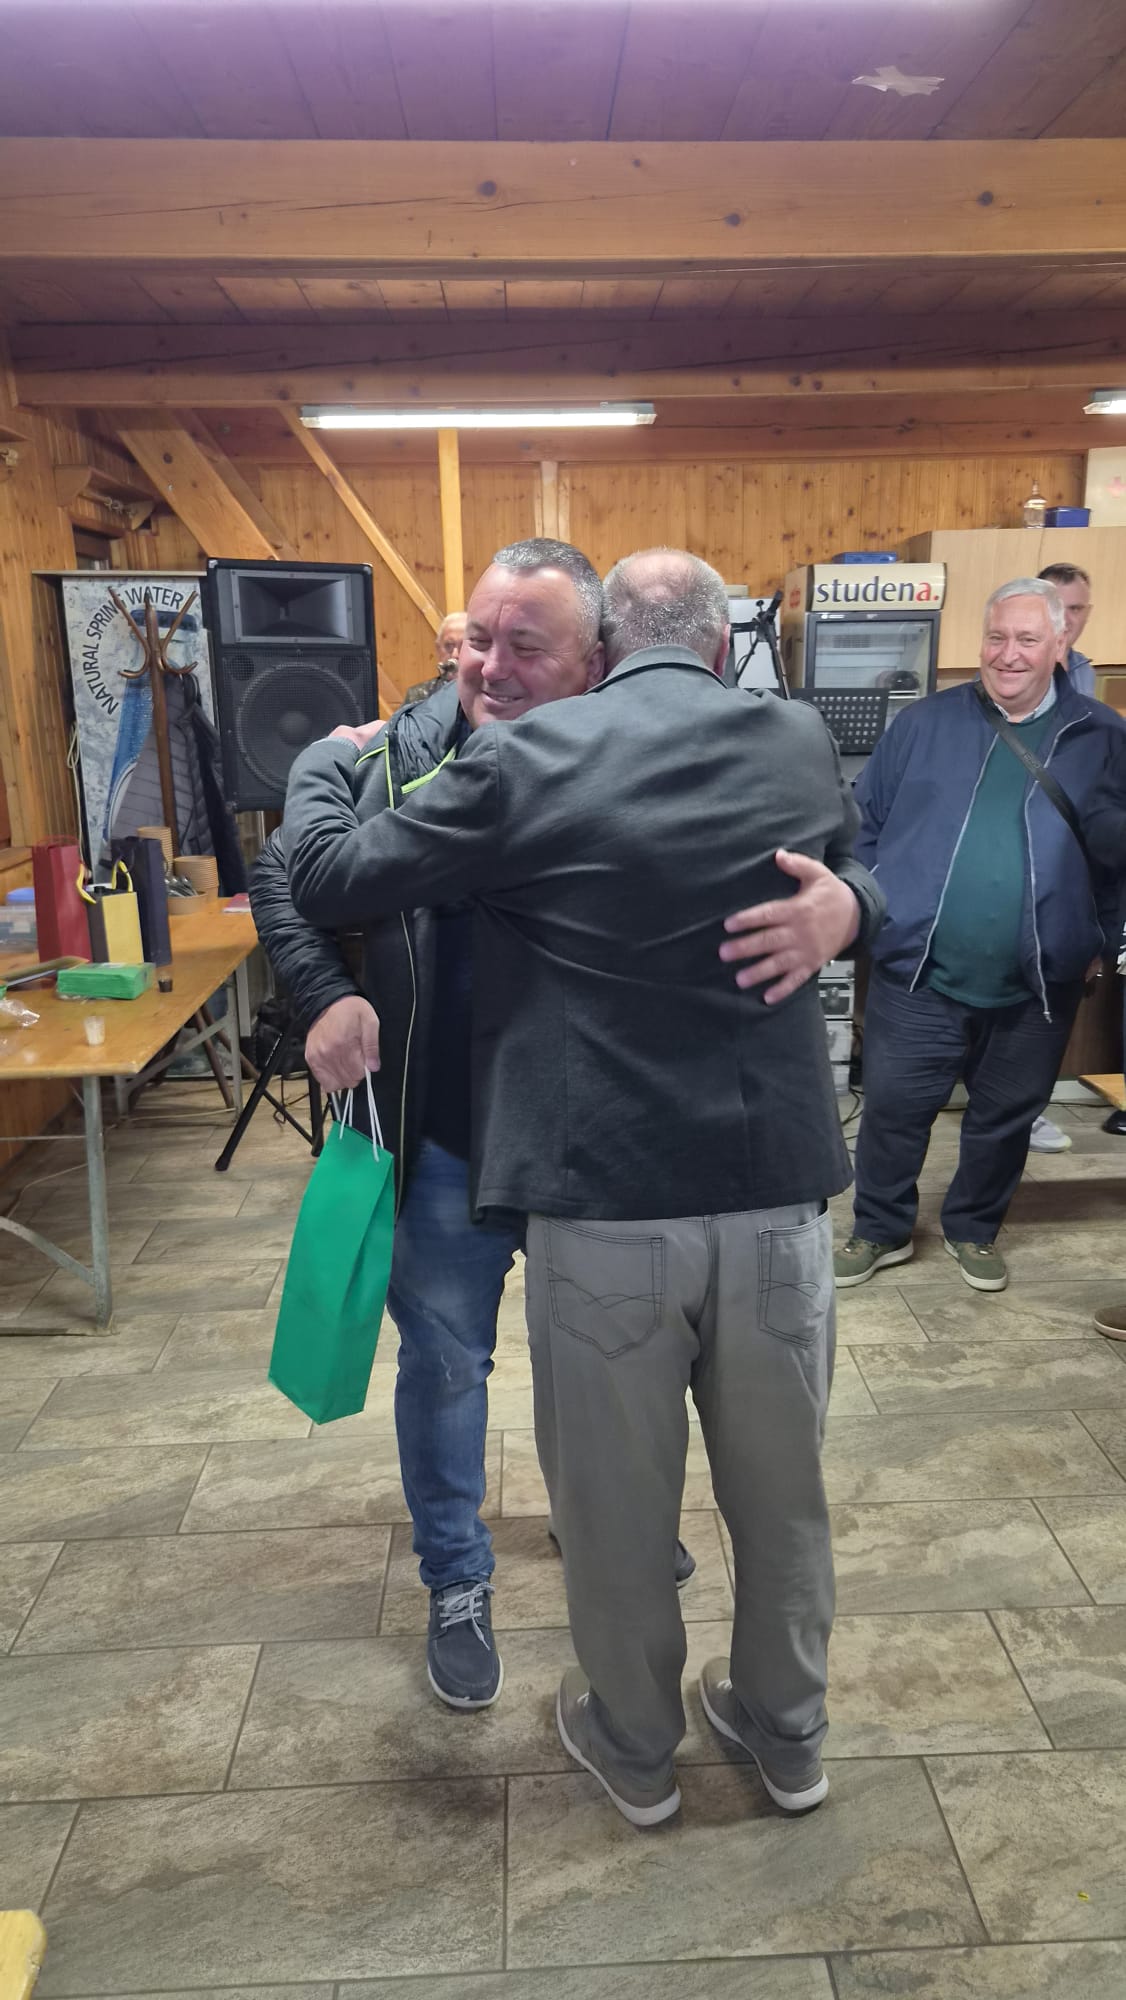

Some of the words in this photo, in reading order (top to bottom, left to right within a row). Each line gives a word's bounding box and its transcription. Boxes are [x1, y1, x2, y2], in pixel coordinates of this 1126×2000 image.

[816, 575, 940, 603] studena.
[82, 643, 119, 714] NATURAL
[125, 586, 184, 609] WATER
